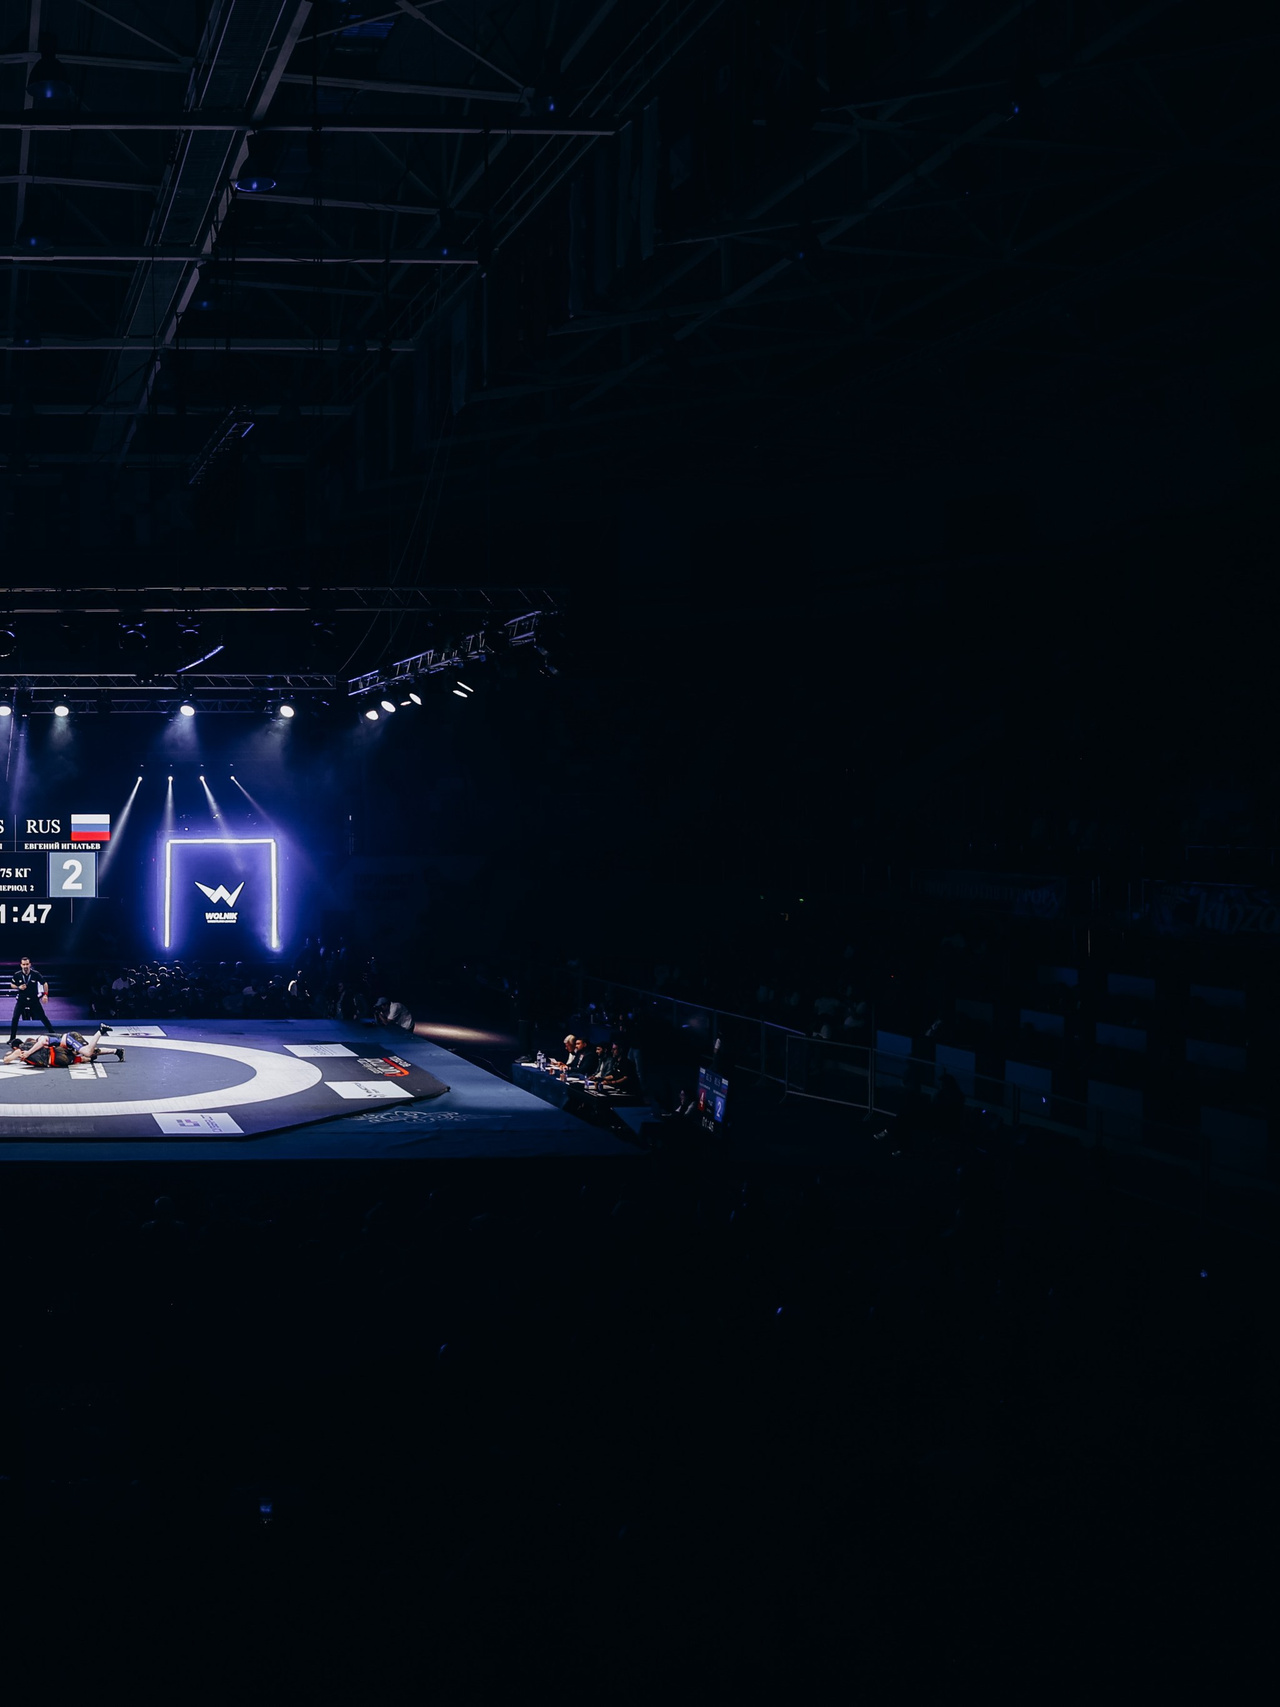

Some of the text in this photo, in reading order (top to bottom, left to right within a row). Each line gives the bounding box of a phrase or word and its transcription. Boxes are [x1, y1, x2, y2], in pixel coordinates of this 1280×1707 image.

[26, 819, 61, 834] RUS
[24, 841, 101, 850] ЕВГЕНИЙ ИГНАТЬЕВ
[0, 868, 32, 878] 75 КГ
[61, 859, 83, 890] 2
[29, 884, 35, 892] 2
[205, 912, 238, 920] WOLNIK
